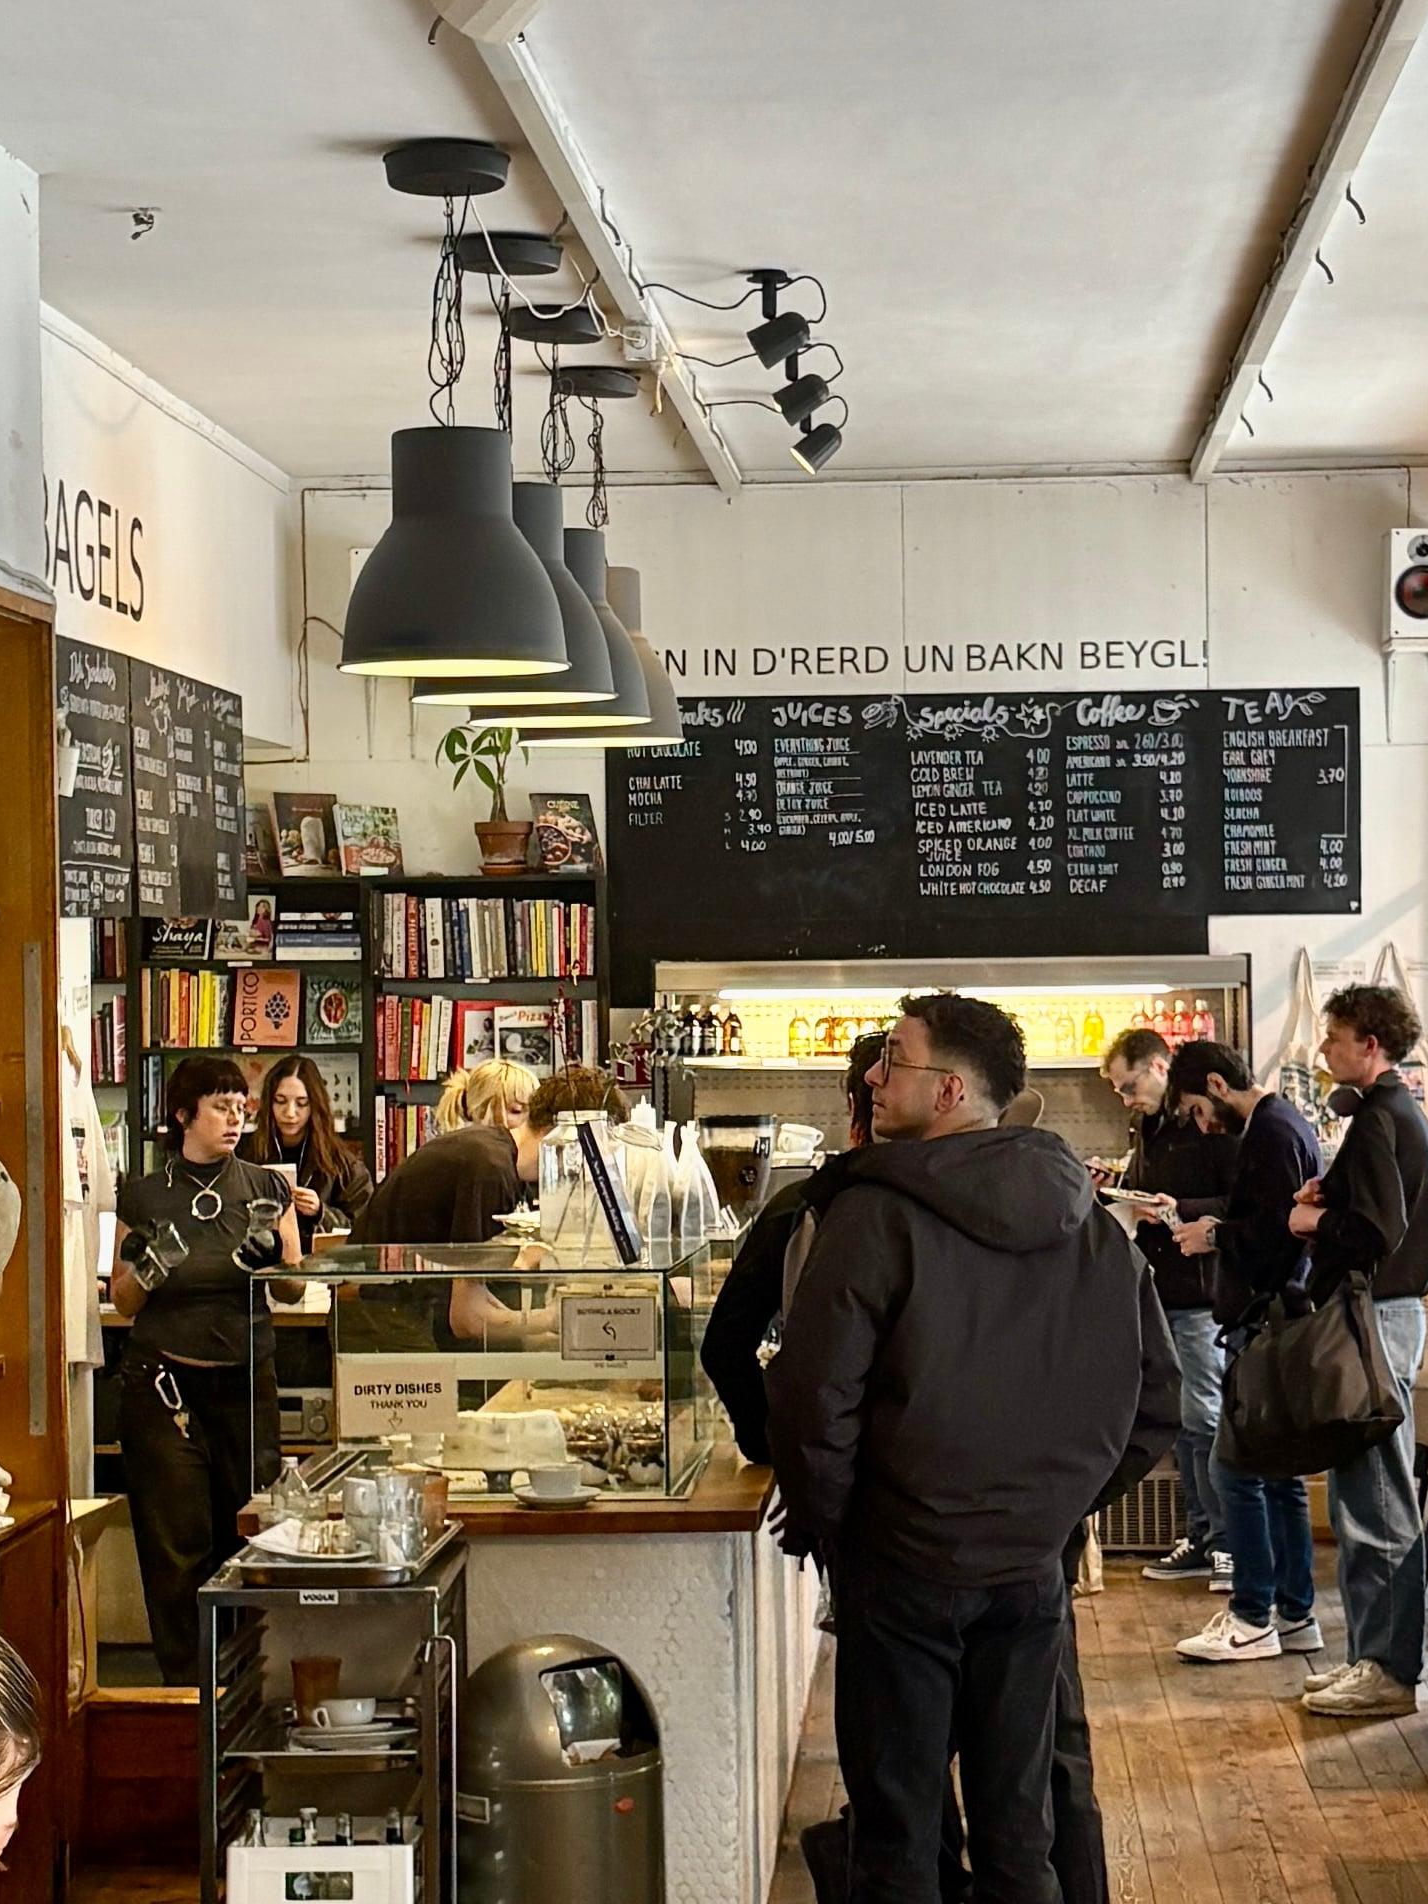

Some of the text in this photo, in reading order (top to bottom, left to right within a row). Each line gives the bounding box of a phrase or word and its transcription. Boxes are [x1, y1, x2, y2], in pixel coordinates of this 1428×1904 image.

[703, 648, 738, 676] IN
[753, 646, 888, 676] D'RERD
[903, 645, 954, 674] UN
[967, 643, 1063, 672] BAKN
[772, 702, 852, 727] JUICES
[1077, 695, 1146, 727] Coffee
[1221, 691, 1284, 724] TEA
[1066, 735, 1110, 750] ESPRESSO
[1223, 728, 1329, 747] ENGLISH BREAKFAST
[911, 750, 983, 765] LAVENDER TEA
[911, 767, 974, 782] COLD BREW
[1067, 773, 1094, 787] LATTE
[655, 775, 682, 790] LATTE
[982, 781, 1002, 796] TEA
[628, 792, 662, 806] MOCHA
[915, 802, 987, 817] ICED LATTE
[1067, 809, 1088, 822] FLAT
[628, 812, 663, 826] FILTER
[916, 817, 1011, 834] ICED AMERICANO
[918, 837, 1017, 854] SPICED ORANGE
[926, 850, 961, 862] JUICE
[920, 863, 999, 877] LONDON FOG
[920, 881, 1025, 895] WHITE HOT CHOCOLATE
[1070, 879, 1107, 893] DECAF
[240, 972, 260, 1042] PORTICO
[354, 1382, 443, 1395] DIRTY DISHES
[404, 1398, 428, 1410] YOU
